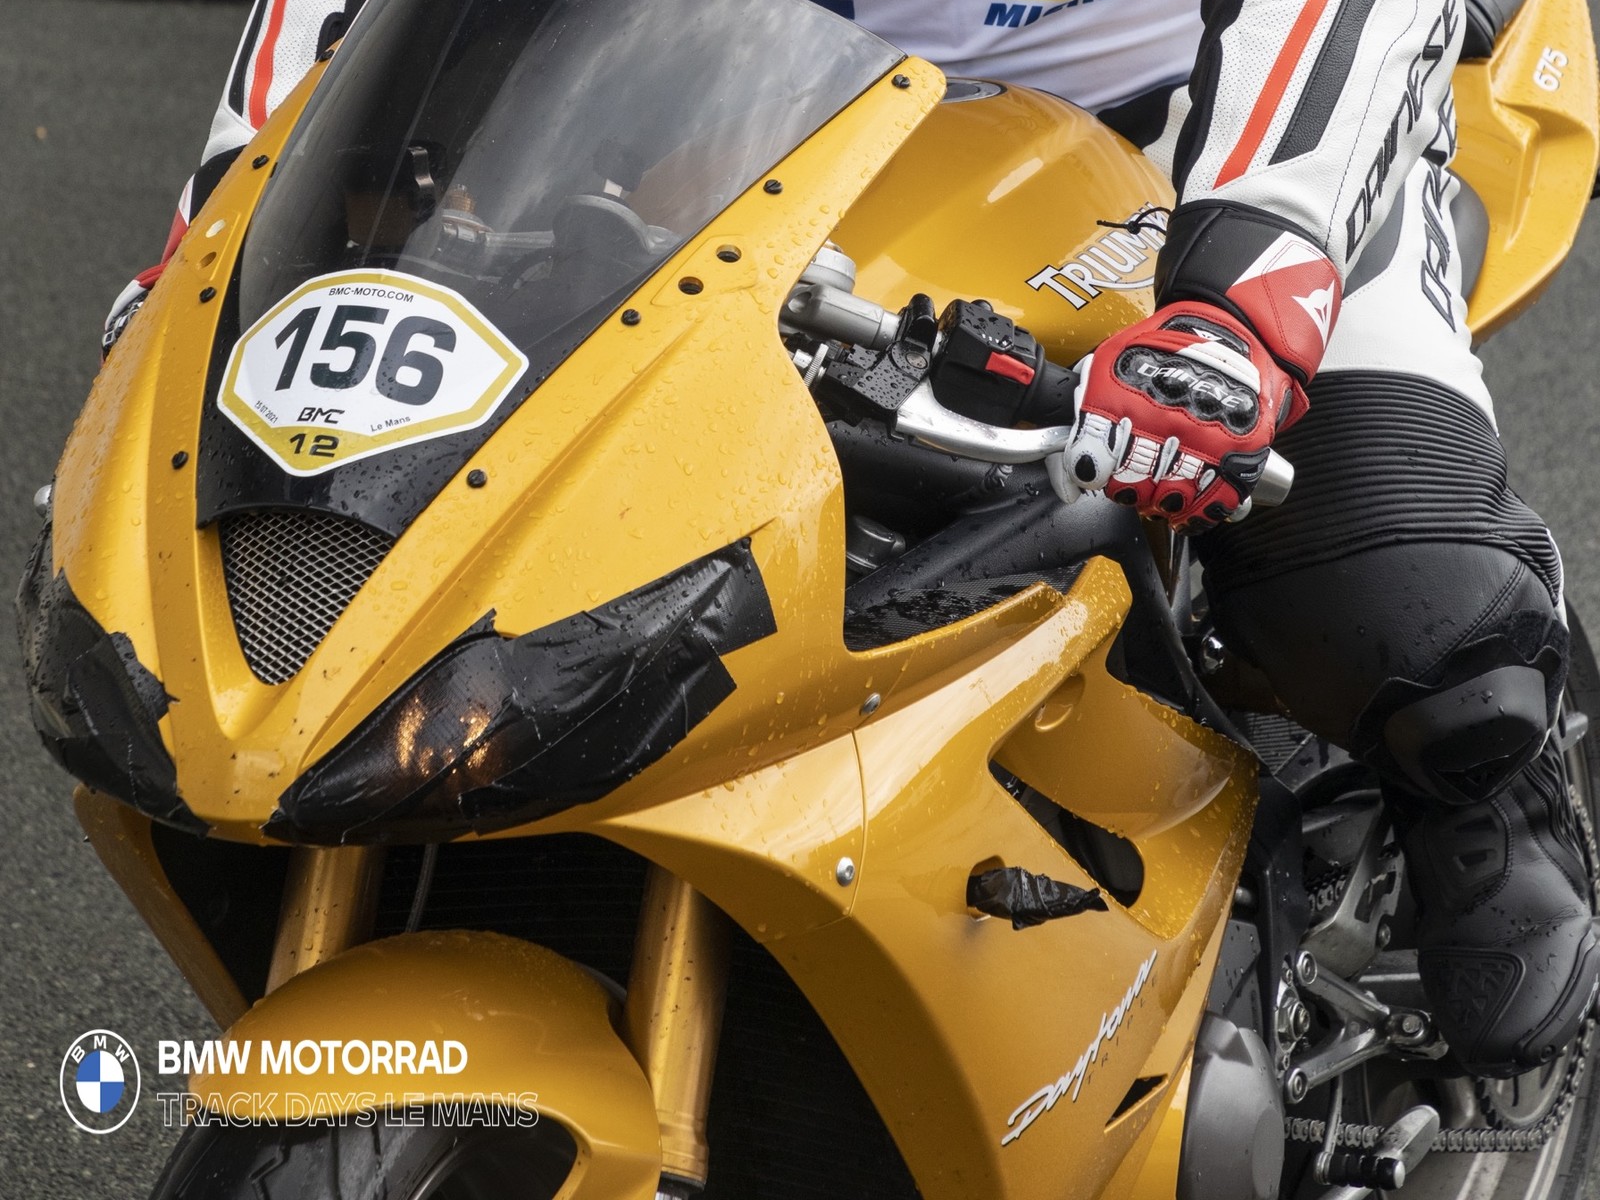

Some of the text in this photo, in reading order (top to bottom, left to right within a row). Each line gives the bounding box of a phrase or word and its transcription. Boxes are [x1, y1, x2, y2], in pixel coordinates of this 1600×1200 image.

[1532, 45, 1569, 93] 675
[328, 286, 415, 303] BMC-MOTO.COM
[275, 304, 457, 406] 156
[1137, 362, 1244, 408] DAINESE
[296, 406, 346, 425] BMC
[370, 415, 411, 433] Le Mans
[289, 432, 340, 458] 12
[1001, 949, 1157, 1143] Daytona
